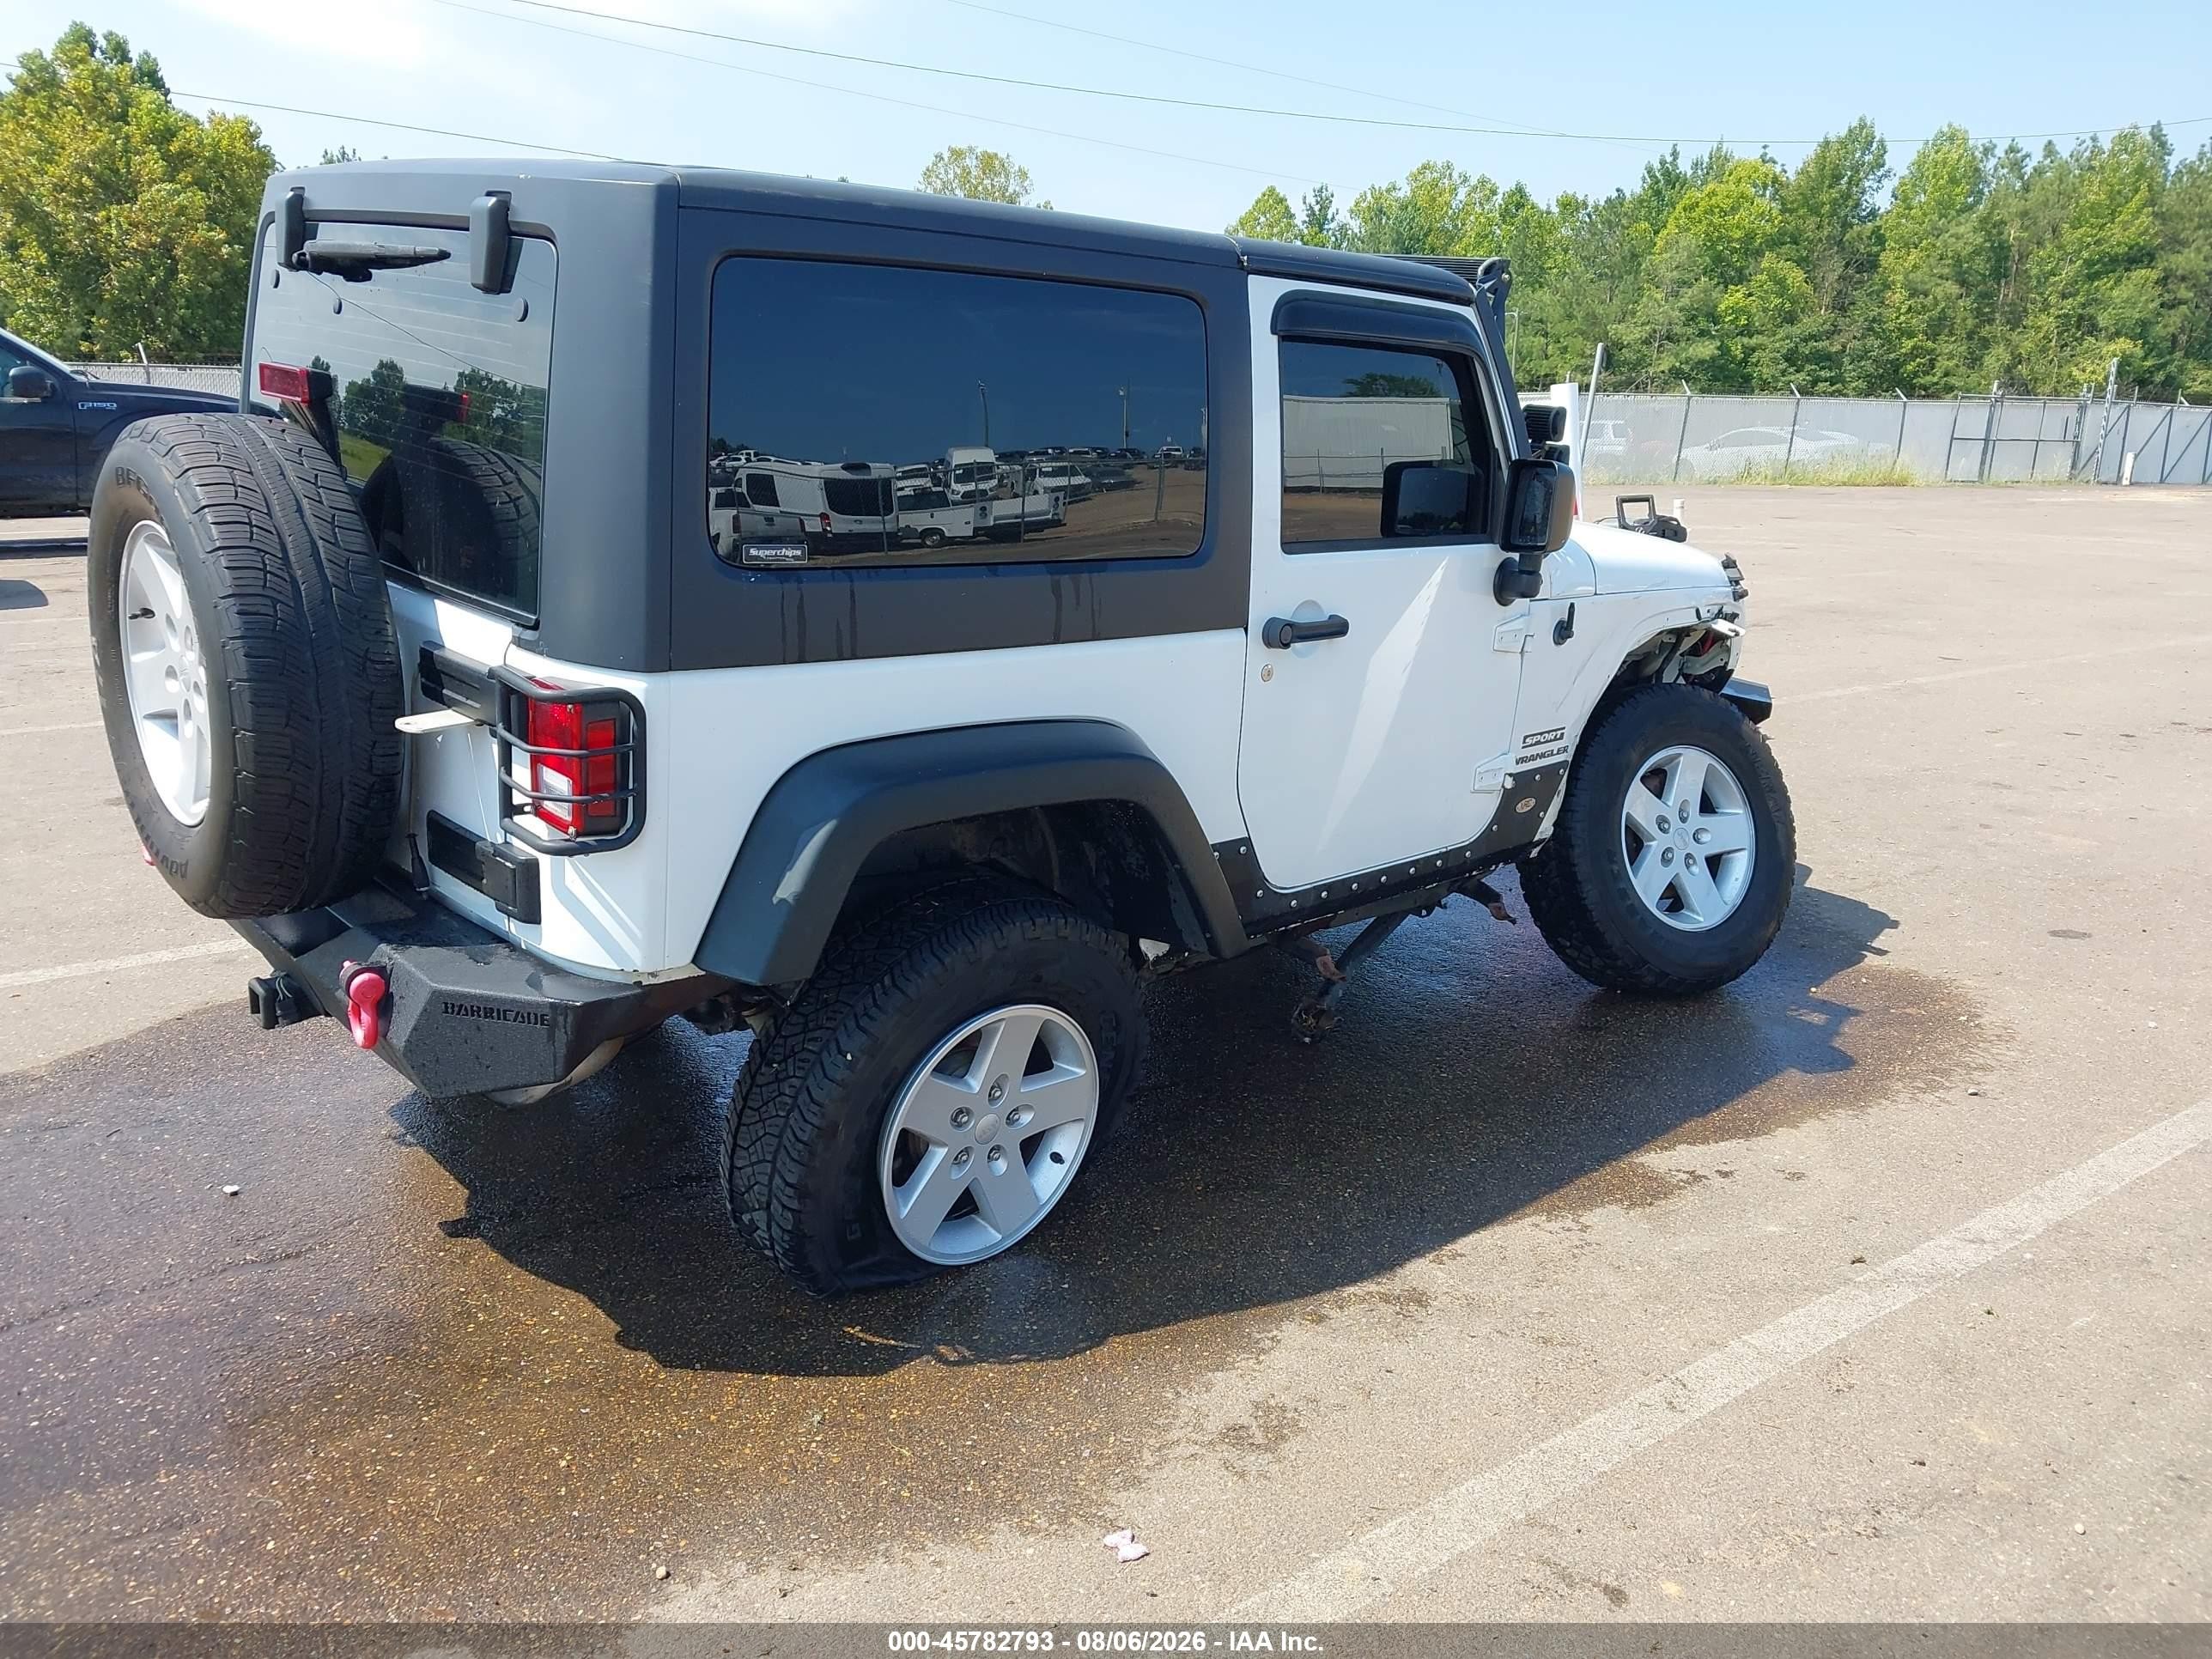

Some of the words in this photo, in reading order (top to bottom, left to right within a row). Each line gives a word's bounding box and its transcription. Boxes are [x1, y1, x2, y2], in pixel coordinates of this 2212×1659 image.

[749, 548, 802, 556] Superchips
[1524, 731, 1563, 745] SPORT
[441, 1001, 550, 1027] BARRICADE
